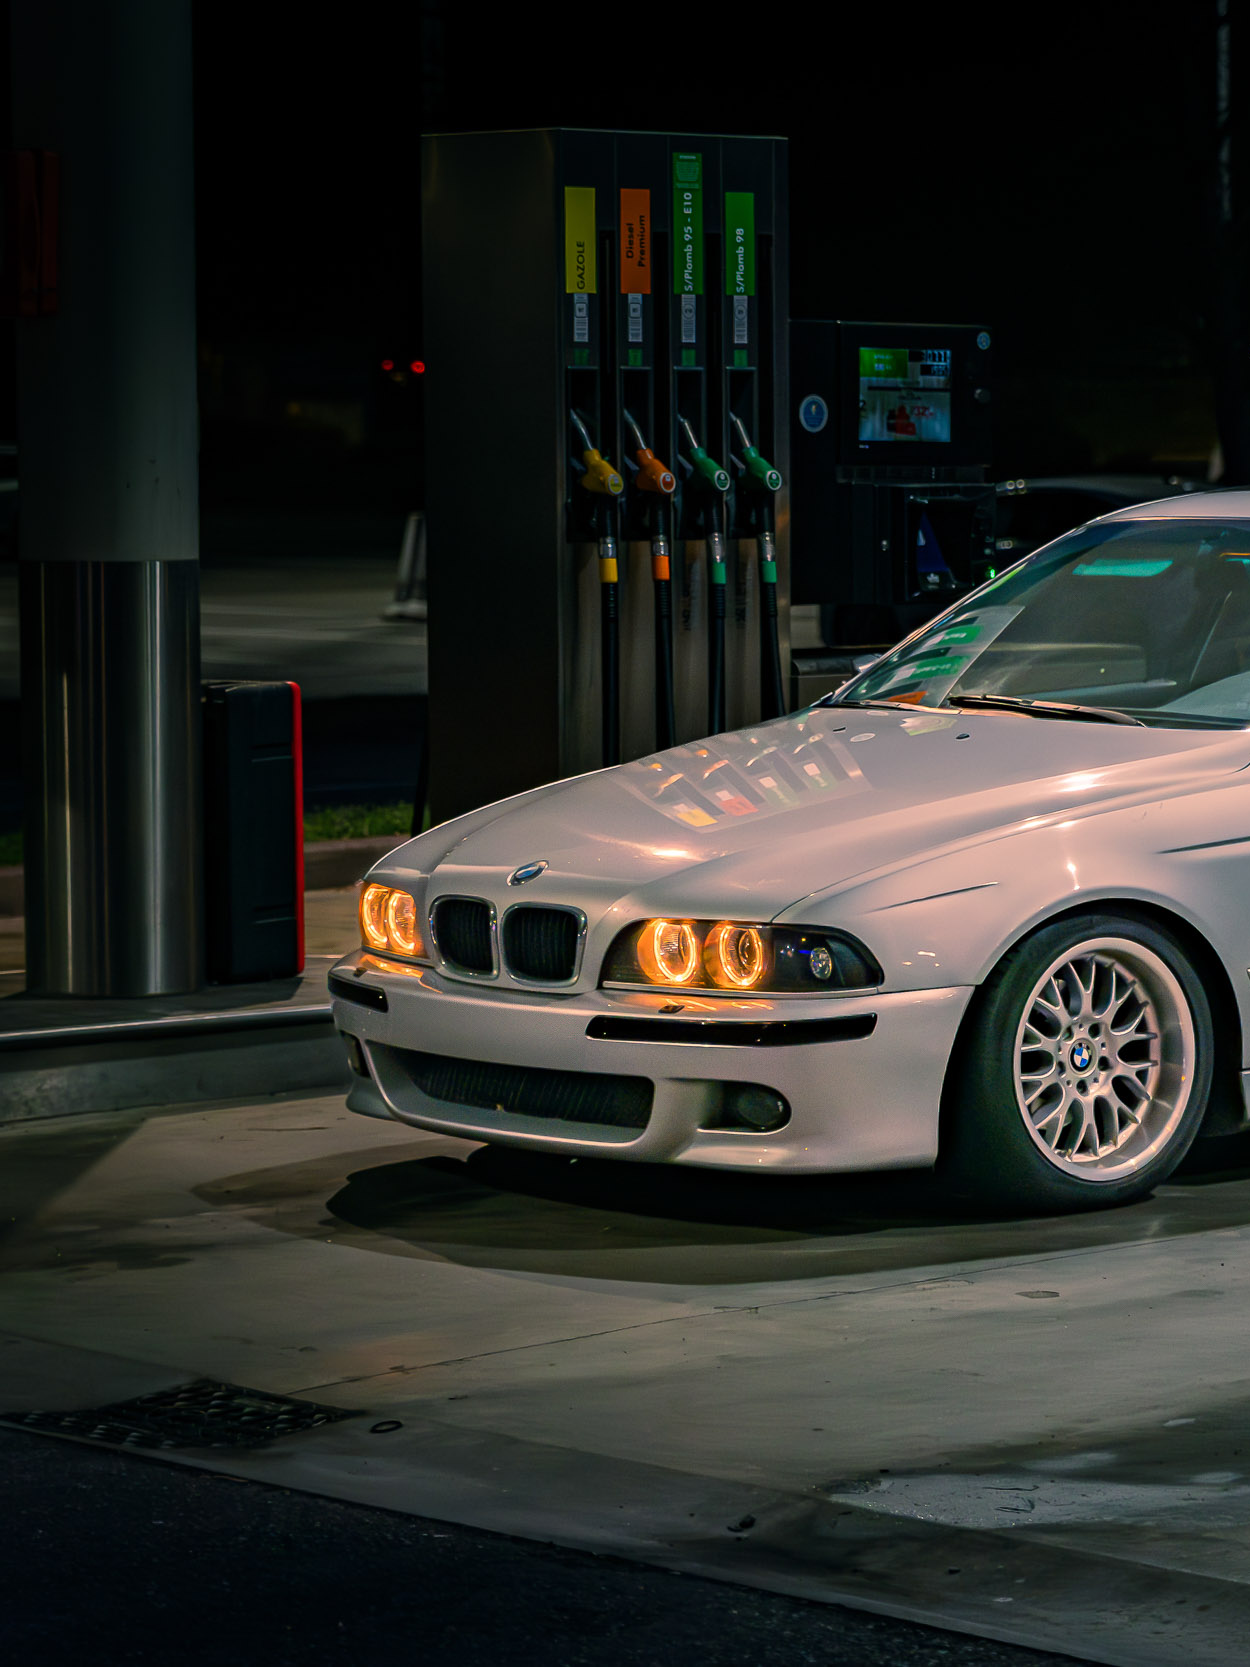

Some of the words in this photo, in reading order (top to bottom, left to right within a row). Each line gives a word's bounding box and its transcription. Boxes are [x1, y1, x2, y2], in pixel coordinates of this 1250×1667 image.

[683, 192, 693, 214] E10
[626, 223, 634, 259] Diesel
[637, 215, 646, 268] Premium
[683, 226, 693, 242] 95
[735, 228, 745, 243] 98
[576, 240, 586, 290] GAZOLE
[683, 244, 693, 291] S/Plomb
[735, 245, 745, 293] S/Plomb
